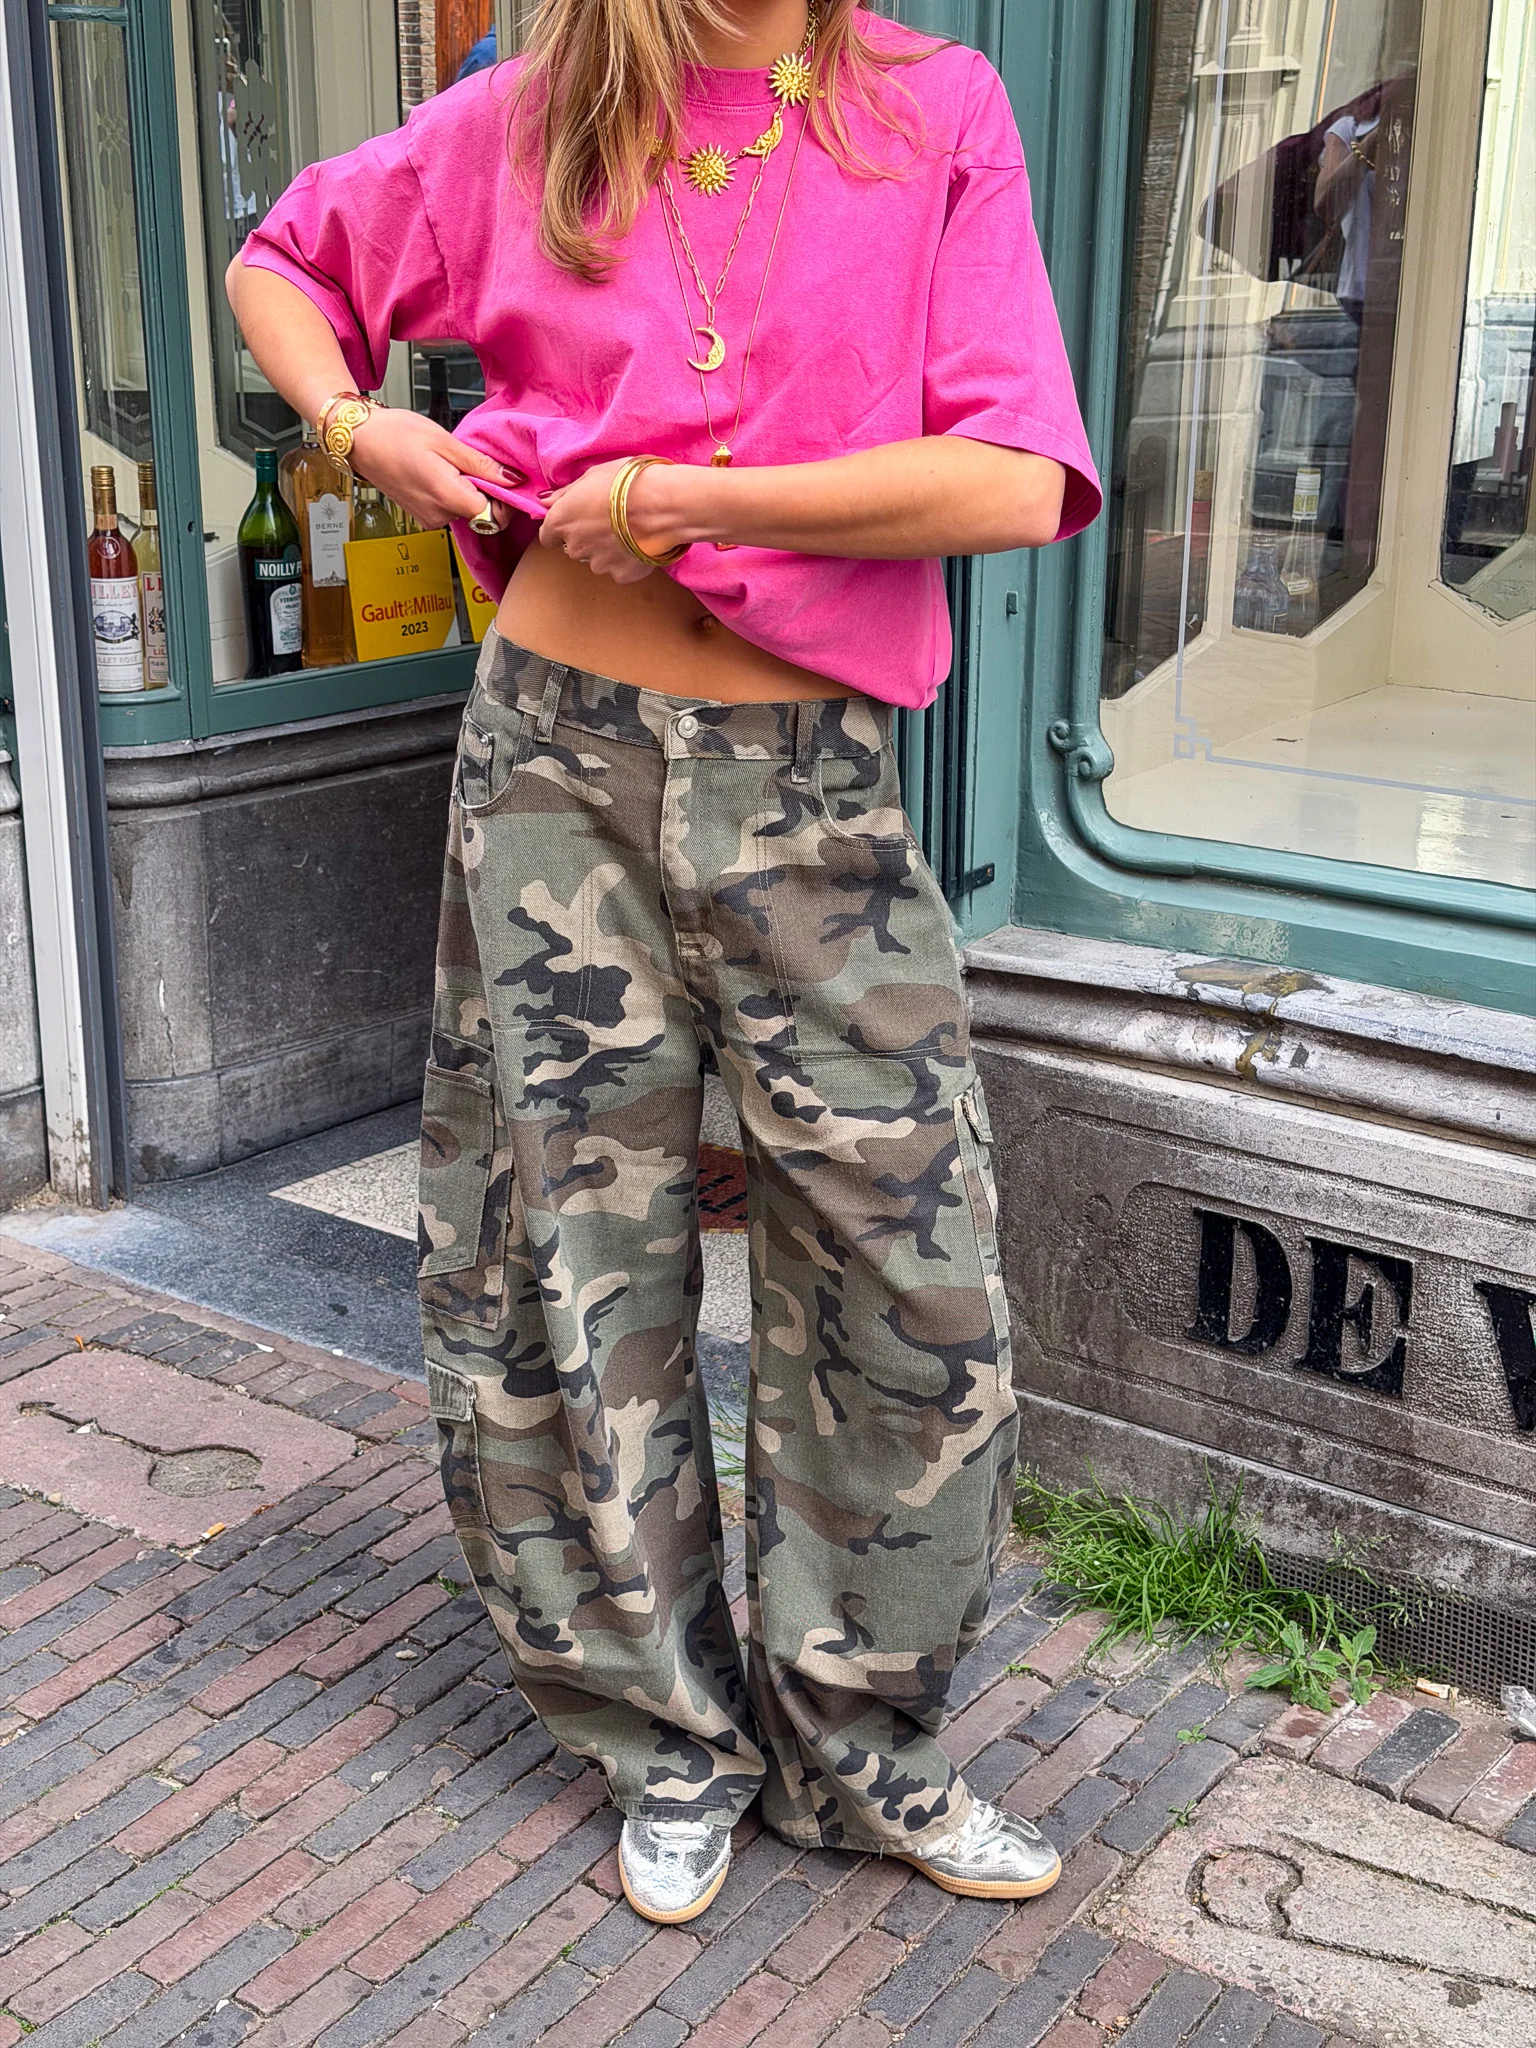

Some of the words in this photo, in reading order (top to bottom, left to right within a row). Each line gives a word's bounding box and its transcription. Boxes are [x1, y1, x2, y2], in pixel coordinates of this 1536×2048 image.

[315, 522, 344, 530] BERNE
[259, 562, 295, 577] NOILLY
[396, 566, 404, 575] 13
[411, 564, 419, 573] 20
[361, 594, 452, 623] Gault&Millau
[401, 621, 429, 636] 2023
[1186, 1206, 1414, 1399] DE
